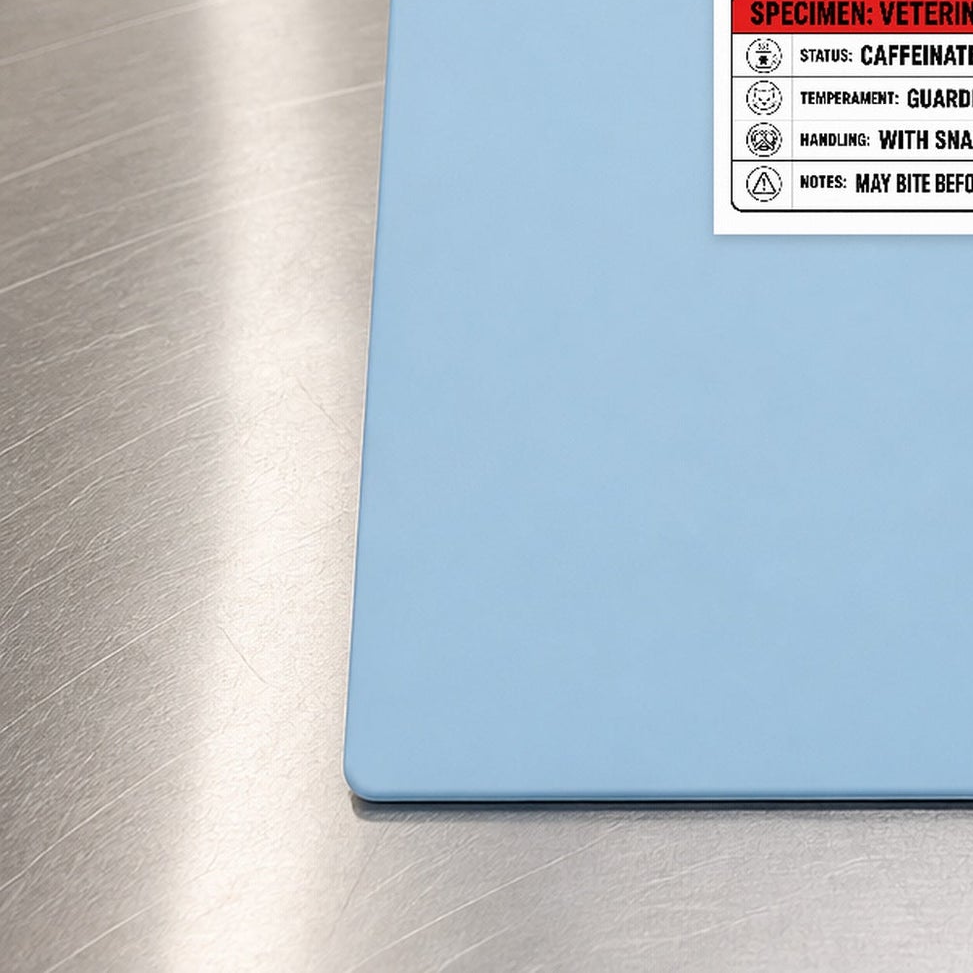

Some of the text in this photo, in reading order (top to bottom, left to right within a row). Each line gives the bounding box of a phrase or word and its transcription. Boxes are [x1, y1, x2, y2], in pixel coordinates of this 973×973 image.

[750, 0, 873, 26] SPECIMEN:
[800, 47, 853, 63] STATUS:
[800, 90, 900, 105] TEMPERAMENT:
[800, 132, 870, 147] HANDLING:
[878, 129, 929, 150] WITH
[799, 174, 847, 189] NOTES:
[855, 173, 892, 194] MAY
[896, 173, 931, 194] BITE
